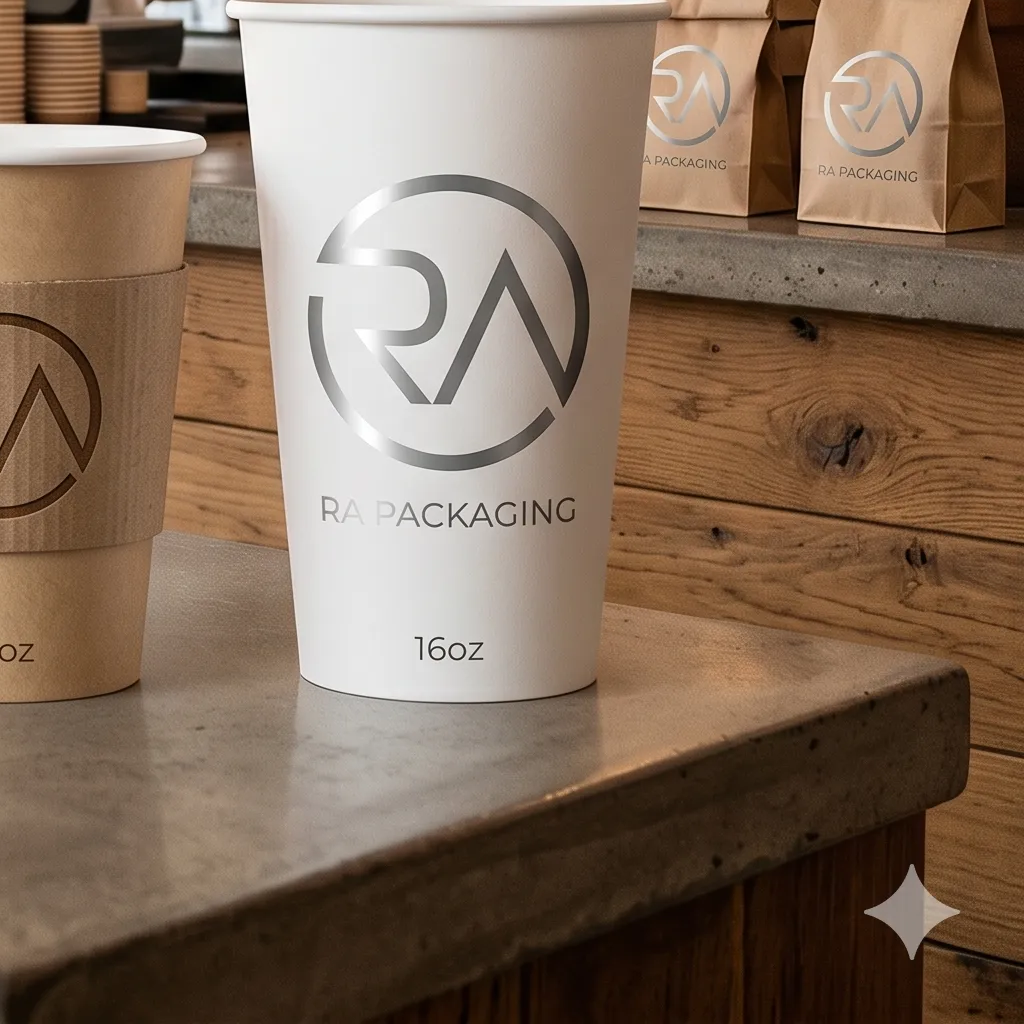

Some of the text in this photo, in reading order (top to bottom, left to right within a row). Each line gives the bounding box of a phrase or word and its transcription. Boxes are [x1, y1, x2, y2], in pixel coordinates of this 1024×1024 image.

[643, 155, 728, 171] A PACKAGING
[818, 164, 918, 183] RA PACKAGING
[320, 495, 576, 528] RA PACKAGING
[414, 636, 484, 661] 16oz
